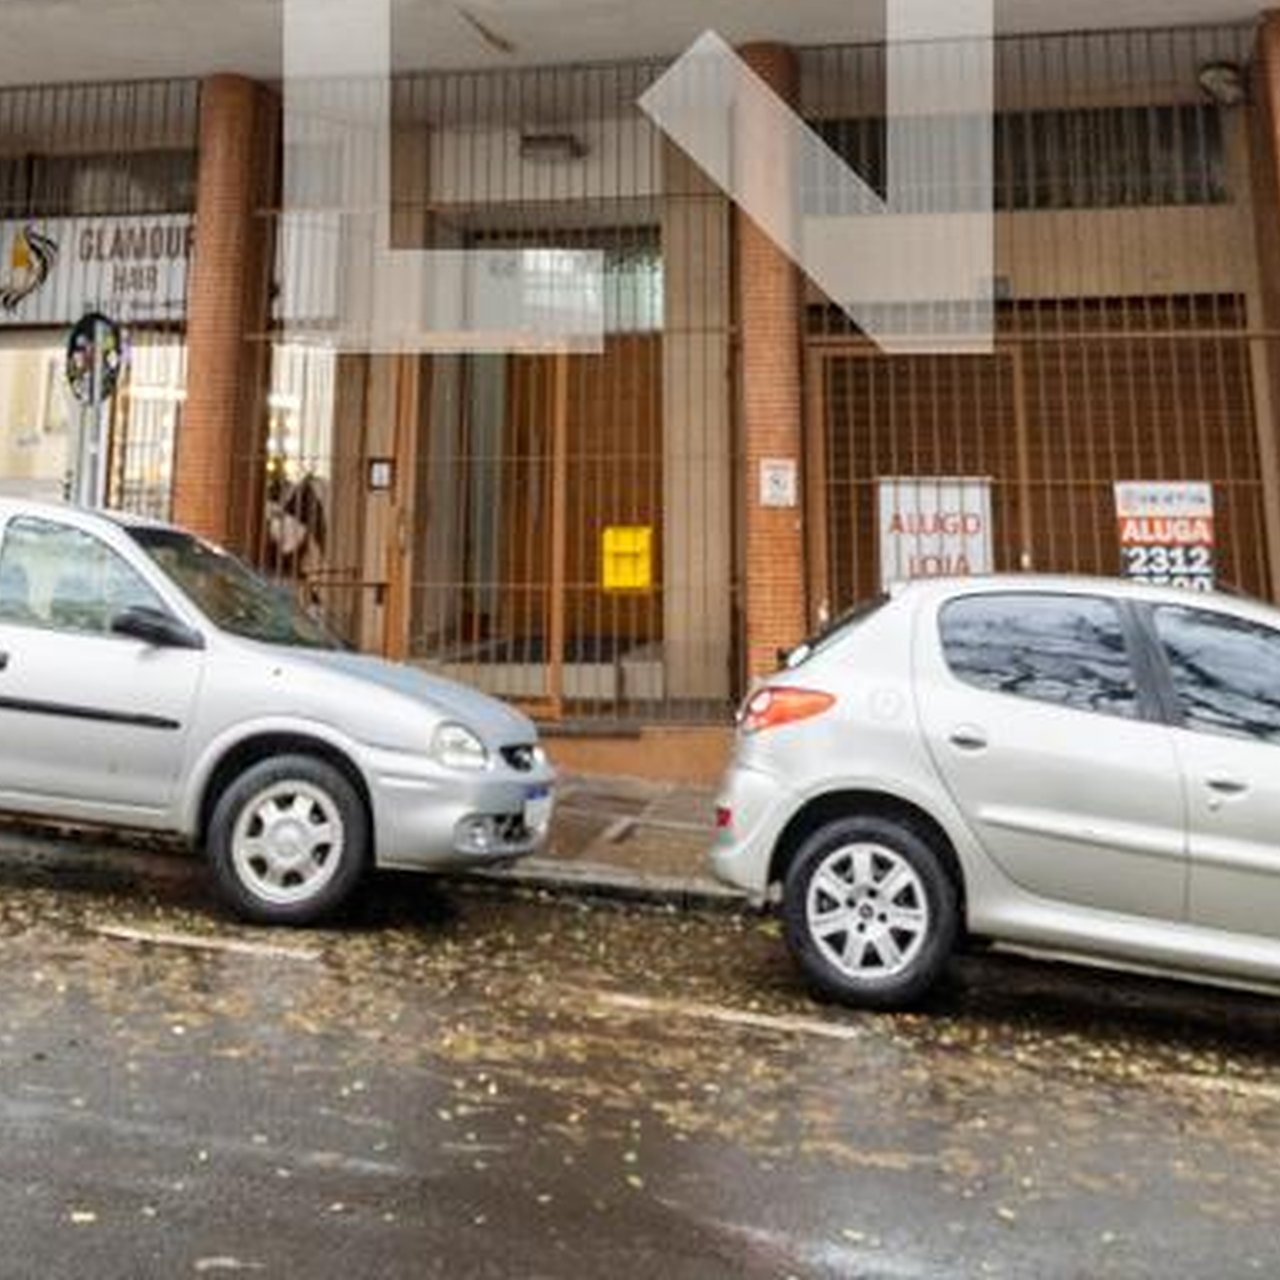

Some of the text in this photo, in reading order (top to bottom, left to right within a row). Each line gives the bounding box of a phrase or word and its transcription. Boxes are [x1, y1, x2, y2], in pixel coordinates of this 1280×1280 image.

[889, 512, 981, 534] ALUGO
[1122, 516, 1213, 543] ALUGA
[1128, 547, 1213, 574] 2312
